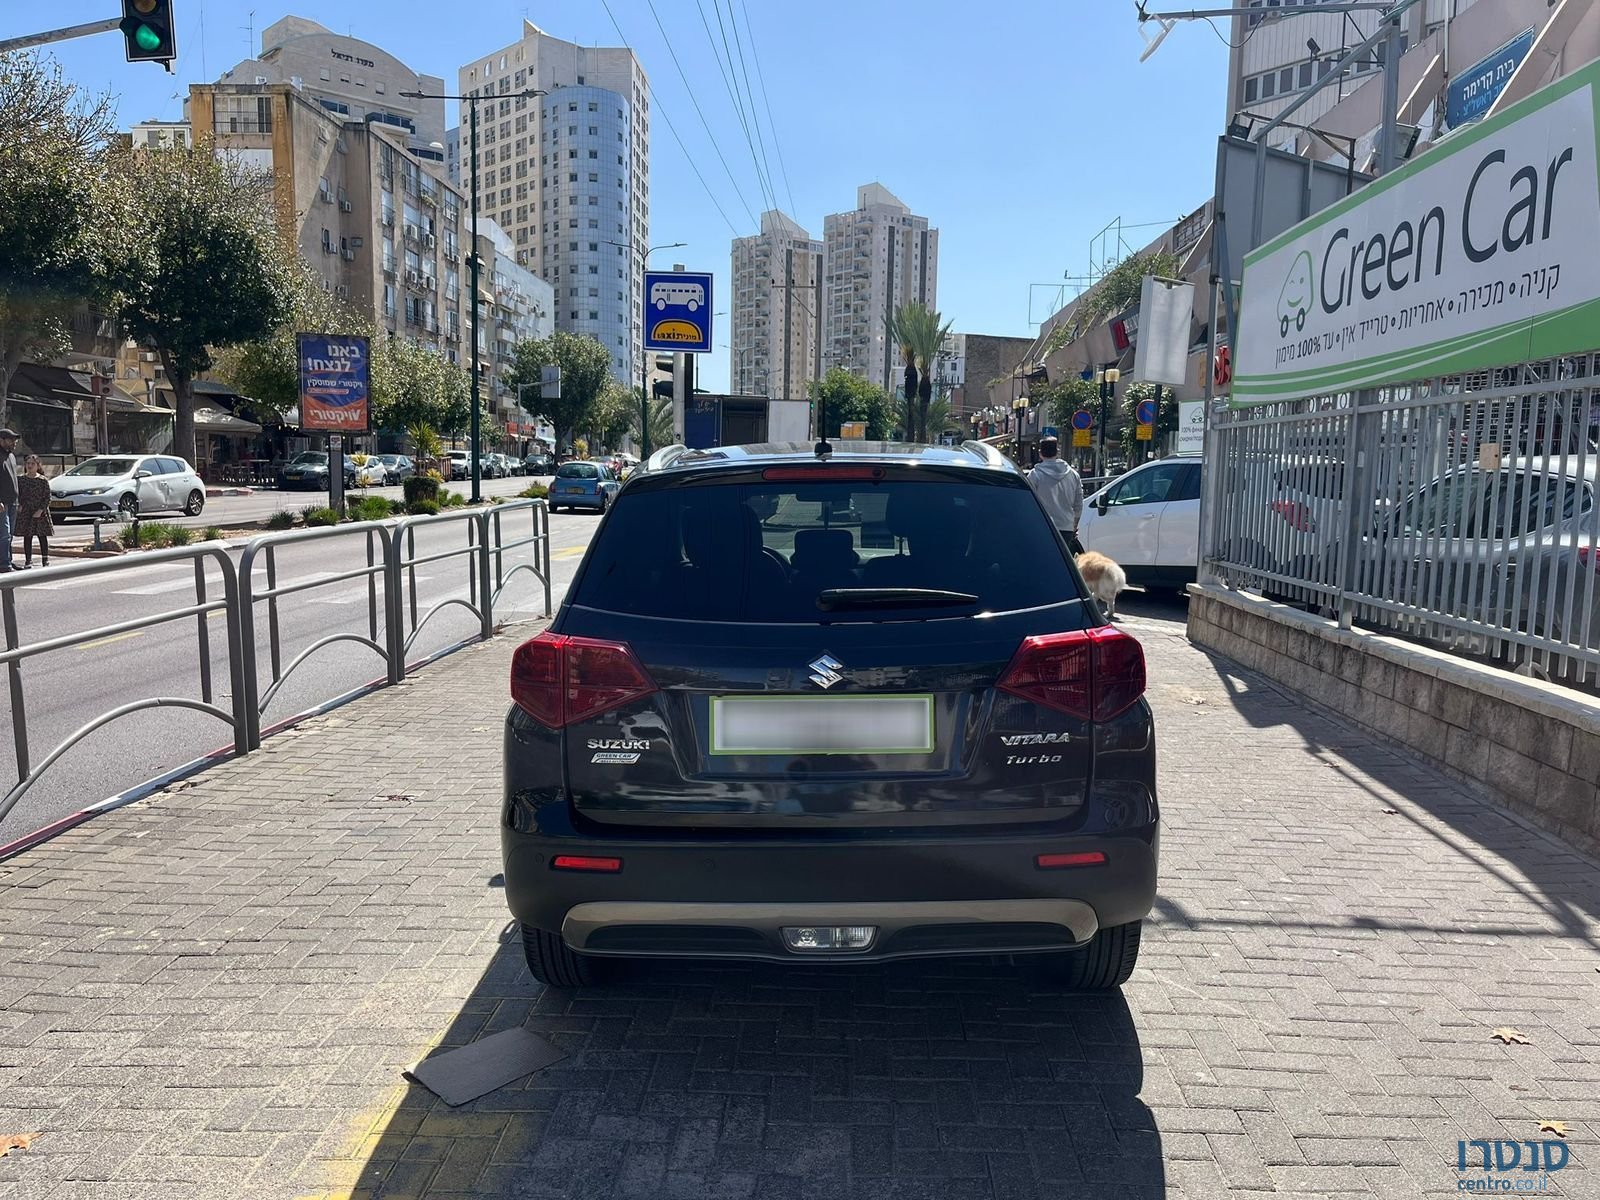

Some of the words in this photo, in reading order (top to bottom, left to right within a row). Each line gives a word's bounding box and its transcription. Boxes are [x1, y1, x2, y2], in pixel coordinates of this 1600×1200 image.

[1496, 58, 1515, 81] בית
[1320, 205, 1445, 314] Green
[1462, 147, 1573, 263] Car
[1519, 264, 1560, 300] קניה
[1457, 280, 1505, 314] מכירה
[1398, 297, 1446, 330] אחריות
[1341, 324, 1356, 352] אין
[1360, 314, 1389, 340] טרייד
[327, 345, 360, 358] באנו
[1297, 335, 1321, 359] 100%
[1323, 331, 1335, 351] עד
[307, 357, 351, 372] לנצח!
[1275, 344, 1295, 369] מימון
[587, 739, 650, 750] SUZUKI
[1000, 732, 1070, 746] VITARA
[1006, 754, 1062, 765] Turbo
